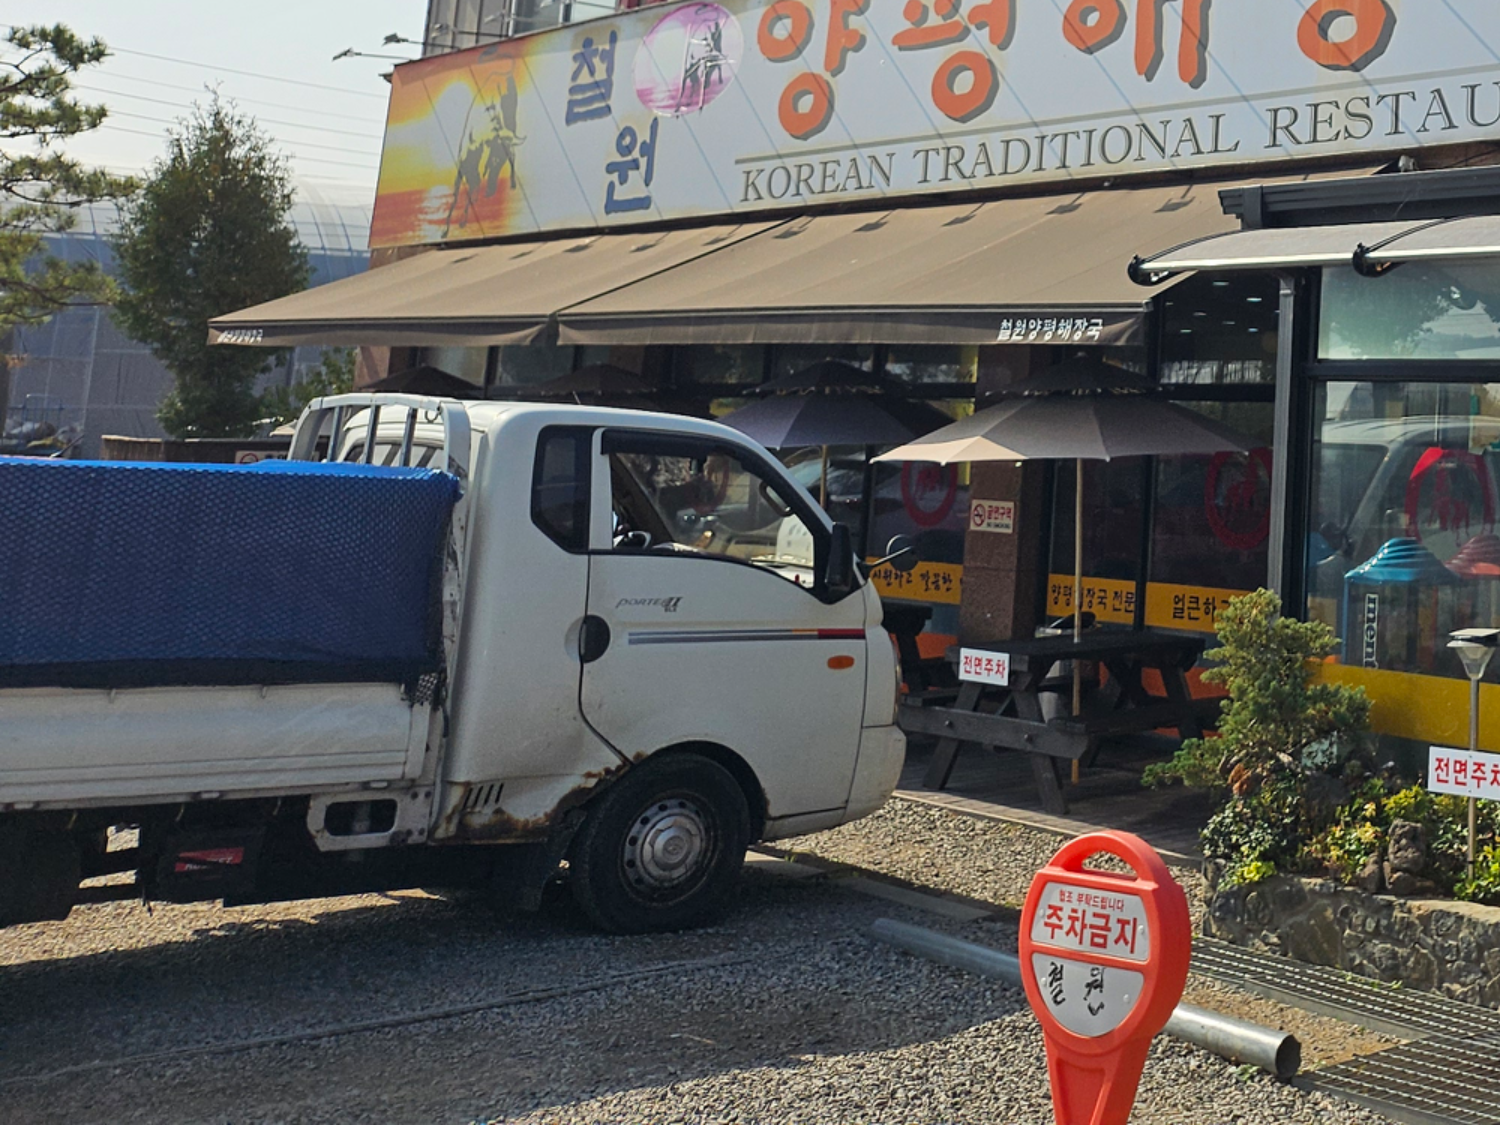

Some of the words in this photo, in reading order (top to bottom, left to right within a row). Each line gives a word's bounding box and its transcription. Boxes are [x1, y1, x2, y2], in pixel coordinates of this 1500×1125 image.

[565, 28, 661, 216] 철원
[741, 153, 896, 203] KOREAN
[914, 112, 1240, 186] TRADITIONAL
[997, 317, 1104, 342] 철원양평해장국
[1051, 583, 1107, 611] 양평장국
[1112, 590, 1136, 614] 전문
[963, 655, 1006, 679] 전면주차
[1059, 888, 1073, 904] 협조
[1076, 892, 1125, 913] 부탁드립니다
[1043, 903, 1138, 955] 주차금지
